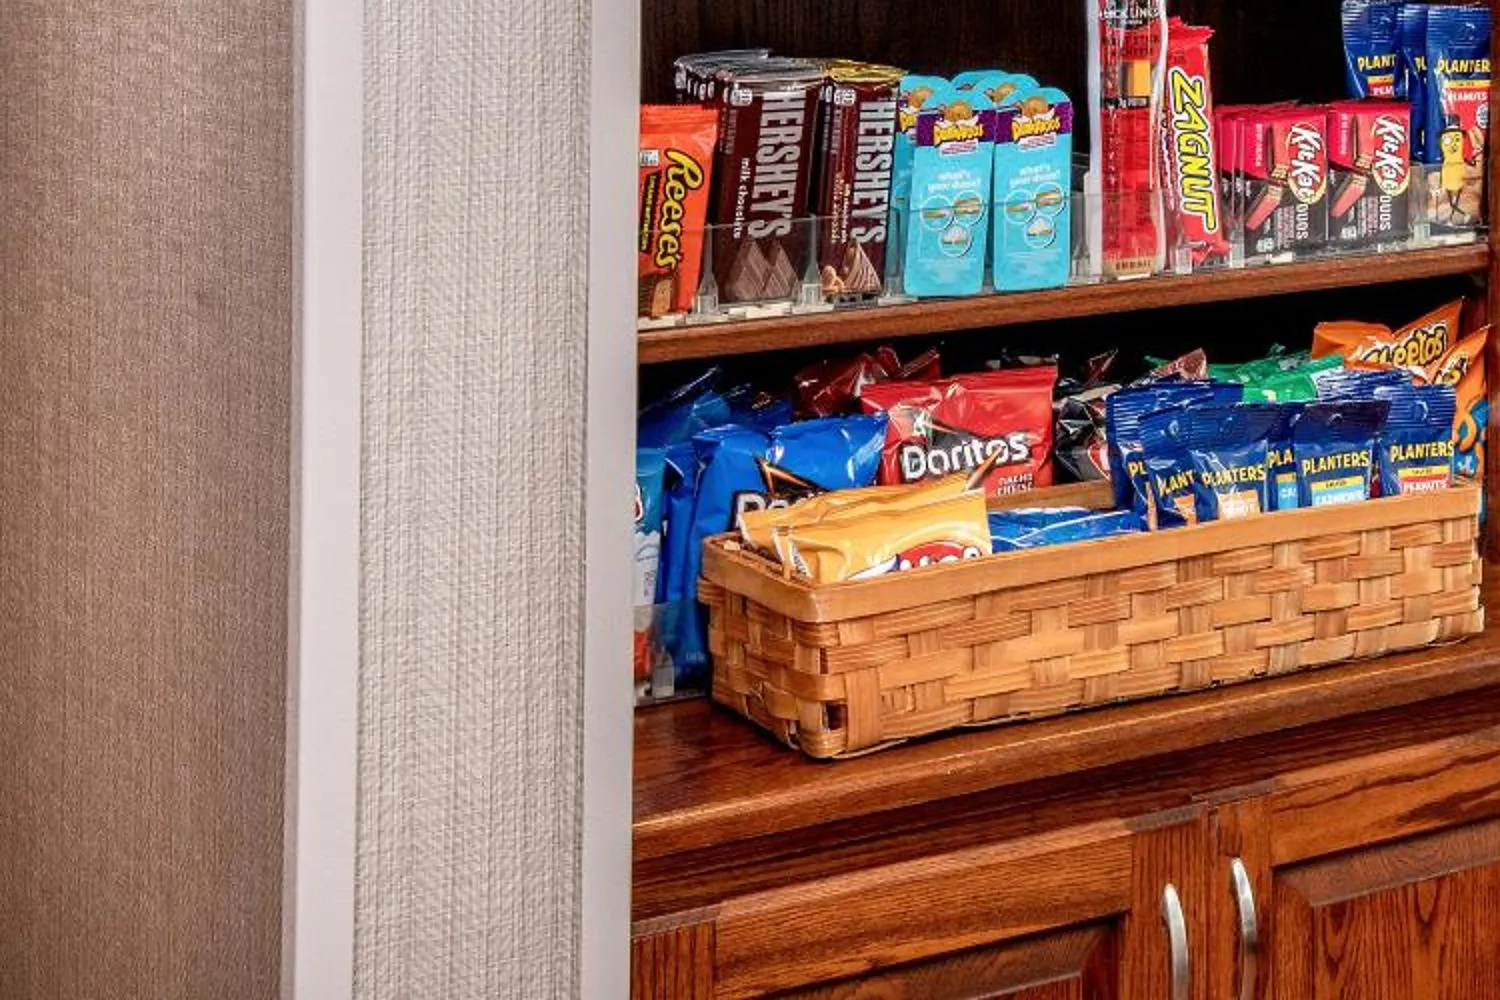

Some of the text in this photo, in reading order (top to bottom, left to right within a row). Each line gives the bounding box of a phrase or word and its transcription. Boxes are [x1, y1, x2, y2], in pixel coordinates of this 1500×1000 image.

[1357, 54, 1397, 72] PLANT
[1437, 58, 1491, 73] PLANTER
[747, 90, 806, 239] HERSHEY'S
[1170, 69, 1217, 231] ZAGNUT
[850, 101, 897, 243] HERSHEY'S
[655, 149, 703, 269] Reese's
[1295, 203, 1309, 240] DUOS
[1379, 195, 1393, 231] DUOS
[902, 432, 1031, 481] Doritos
[1302, 450, 1370, 476] PLANTERS
[1390, 440, 1455, 464] PLANTERS
[1201, 463, 1266, 488] PLANTERS
